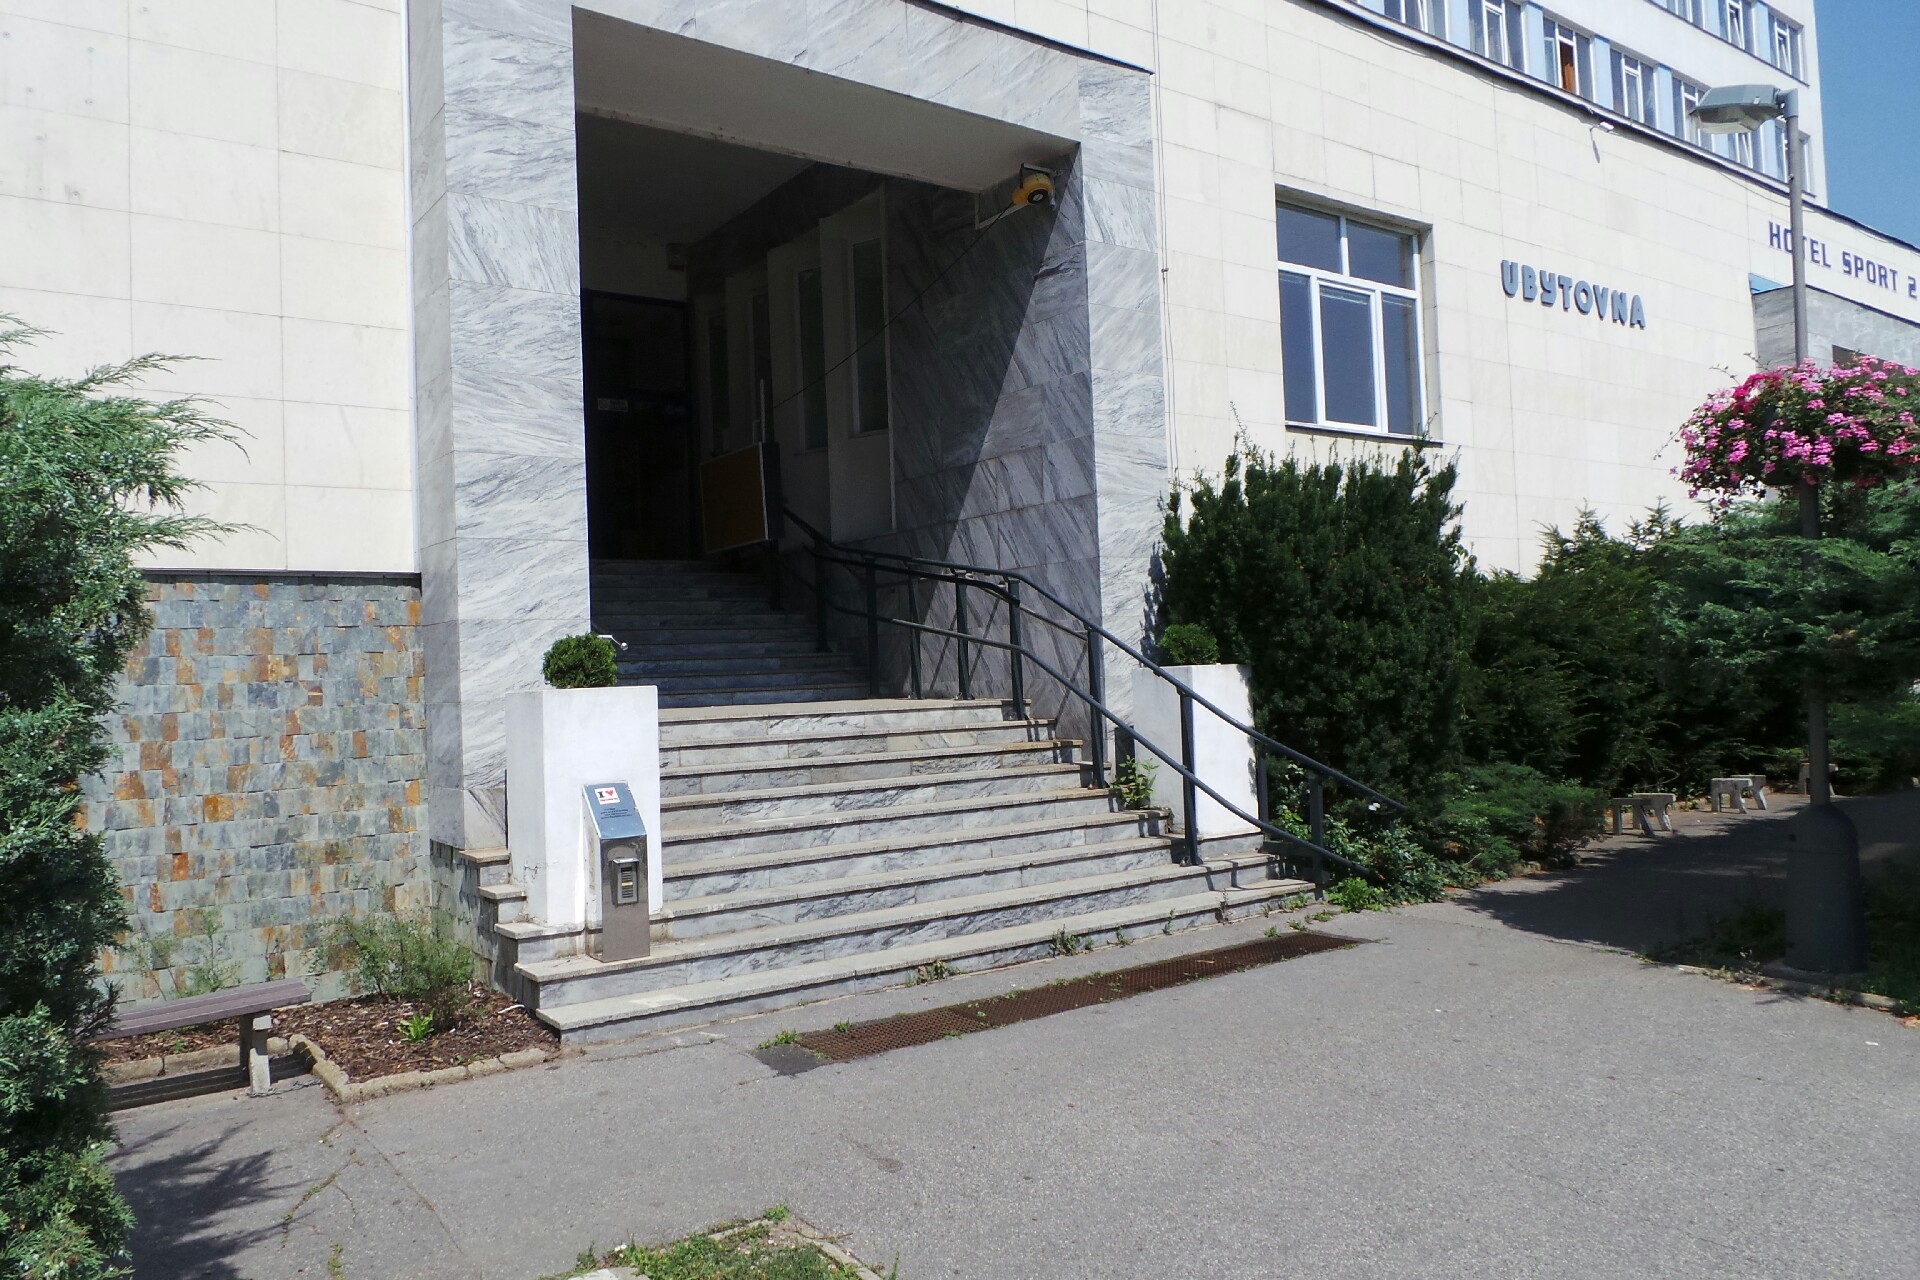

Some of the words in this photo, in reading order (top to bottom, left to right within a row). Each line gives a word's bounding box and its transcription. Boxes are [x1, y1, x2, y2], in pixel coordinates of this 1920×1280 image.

[1500, 259, 1646, 330] UBYTOVNA
[1842, 250, 1898, 291] SPORT
[1907, 275, 1918, 299] 2
